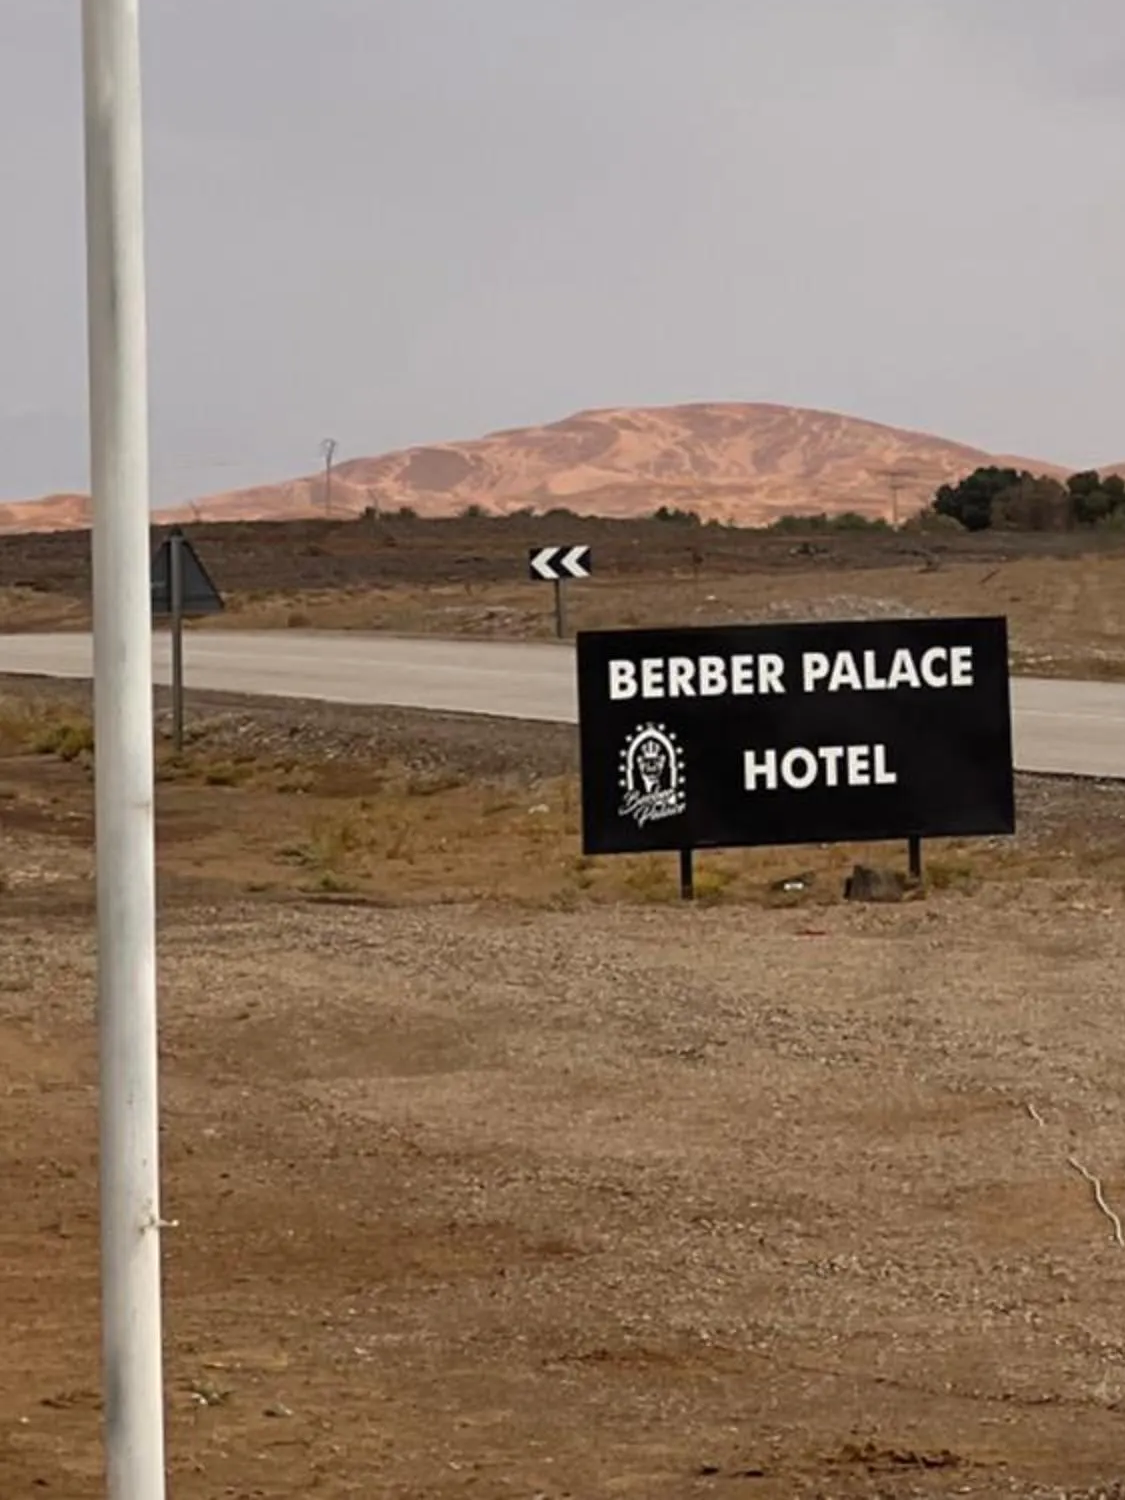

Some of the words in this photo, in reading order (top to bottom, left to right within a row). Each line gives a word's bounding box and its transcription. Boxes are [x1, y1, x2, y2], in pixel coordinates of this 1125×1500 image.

[608, 653, 786, 700] BERBER
[802, 646, 973, 693] PALACE
[744, 744, 897, 791] HOTEL
